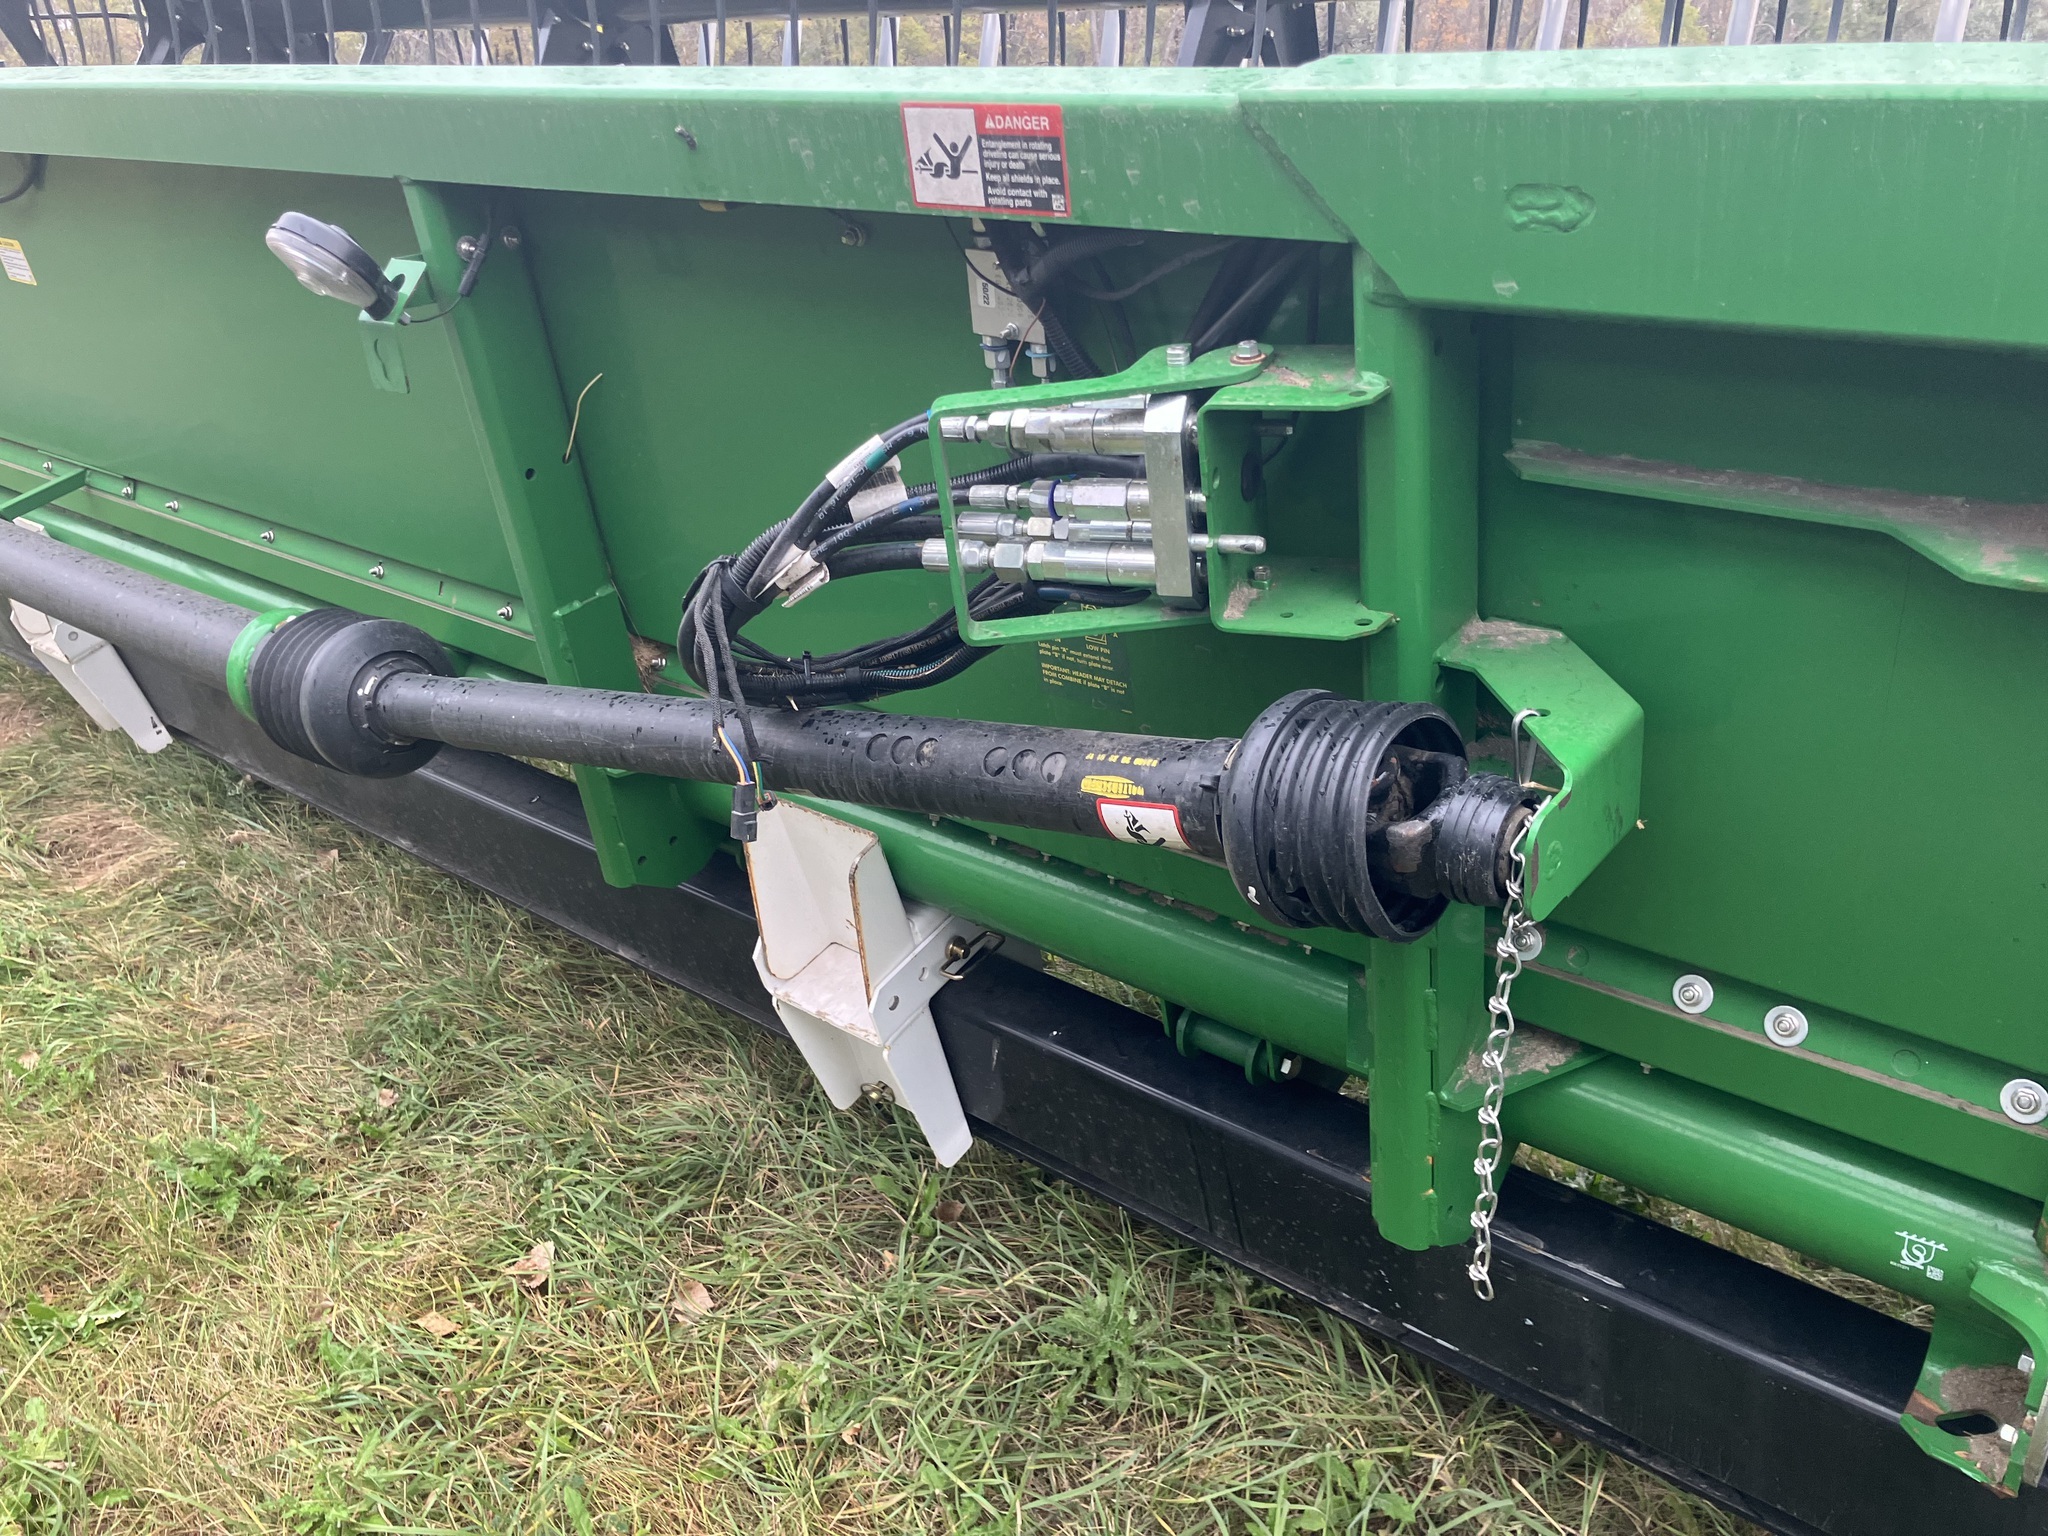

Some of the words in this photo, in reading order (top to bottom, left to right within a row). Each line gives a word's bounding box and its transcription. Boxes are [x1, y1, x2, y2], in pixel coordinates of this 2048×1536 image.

[995, 115, 1050, 130] DANGER
[981, 139, 1021, 151] Entanglement
[1021, 140, 1028, 149] in
[1028, 142, 1053, 153] rotating
[983, 150, 1007, 159] driveline
[1020, 152, 1038, 160] cause
[1038, 153, 1061, 161] serious
[983, 159, 1000, 171] injury
[1001, 161, 1007, 169] or
[985, 172, 1001, 183] Keep
[1002, 172, 1010, 182] all
[1011, 174, 1034, 184] shields
[1034, 175, 1041, 184] in
[1041, 176, 1061, 186] place.
[987, 185, 1006, 196] Avoid
[1007, 188, 1032, 197] contact
[1033, 188, 1048, 198] with
[988, 197, 1014, 208] rotating
[1014, 199, 1032, 208] parts
[981, 282, 990, 306] 50/22
[810, 543, 828, 559] SAE
[833, 529, 850, 543] 100
[855, 517, 874, 531] R17
[1037, 641, 1051, 649] Latch
[1083, 652, 1100, 661] extend
[1100, 655, 1111, 663] thru
[1085, 643, 1099, 652] LOW
[1100, 646, 1111, 654] PIN
[1076, 657, 1088, 665] turn
[1088, 660, 1101, 669] plate
[1042, 669, 1057, 678] FROM
[1057, 673, 1083, 685] COMBINE
[1087, 681, 1101, 689] plate
[1071, 669, 1093, 680] HEADER
[1093, 675, 1105, 683] MAY
[1105, 678, 1128, 688] DETACH
